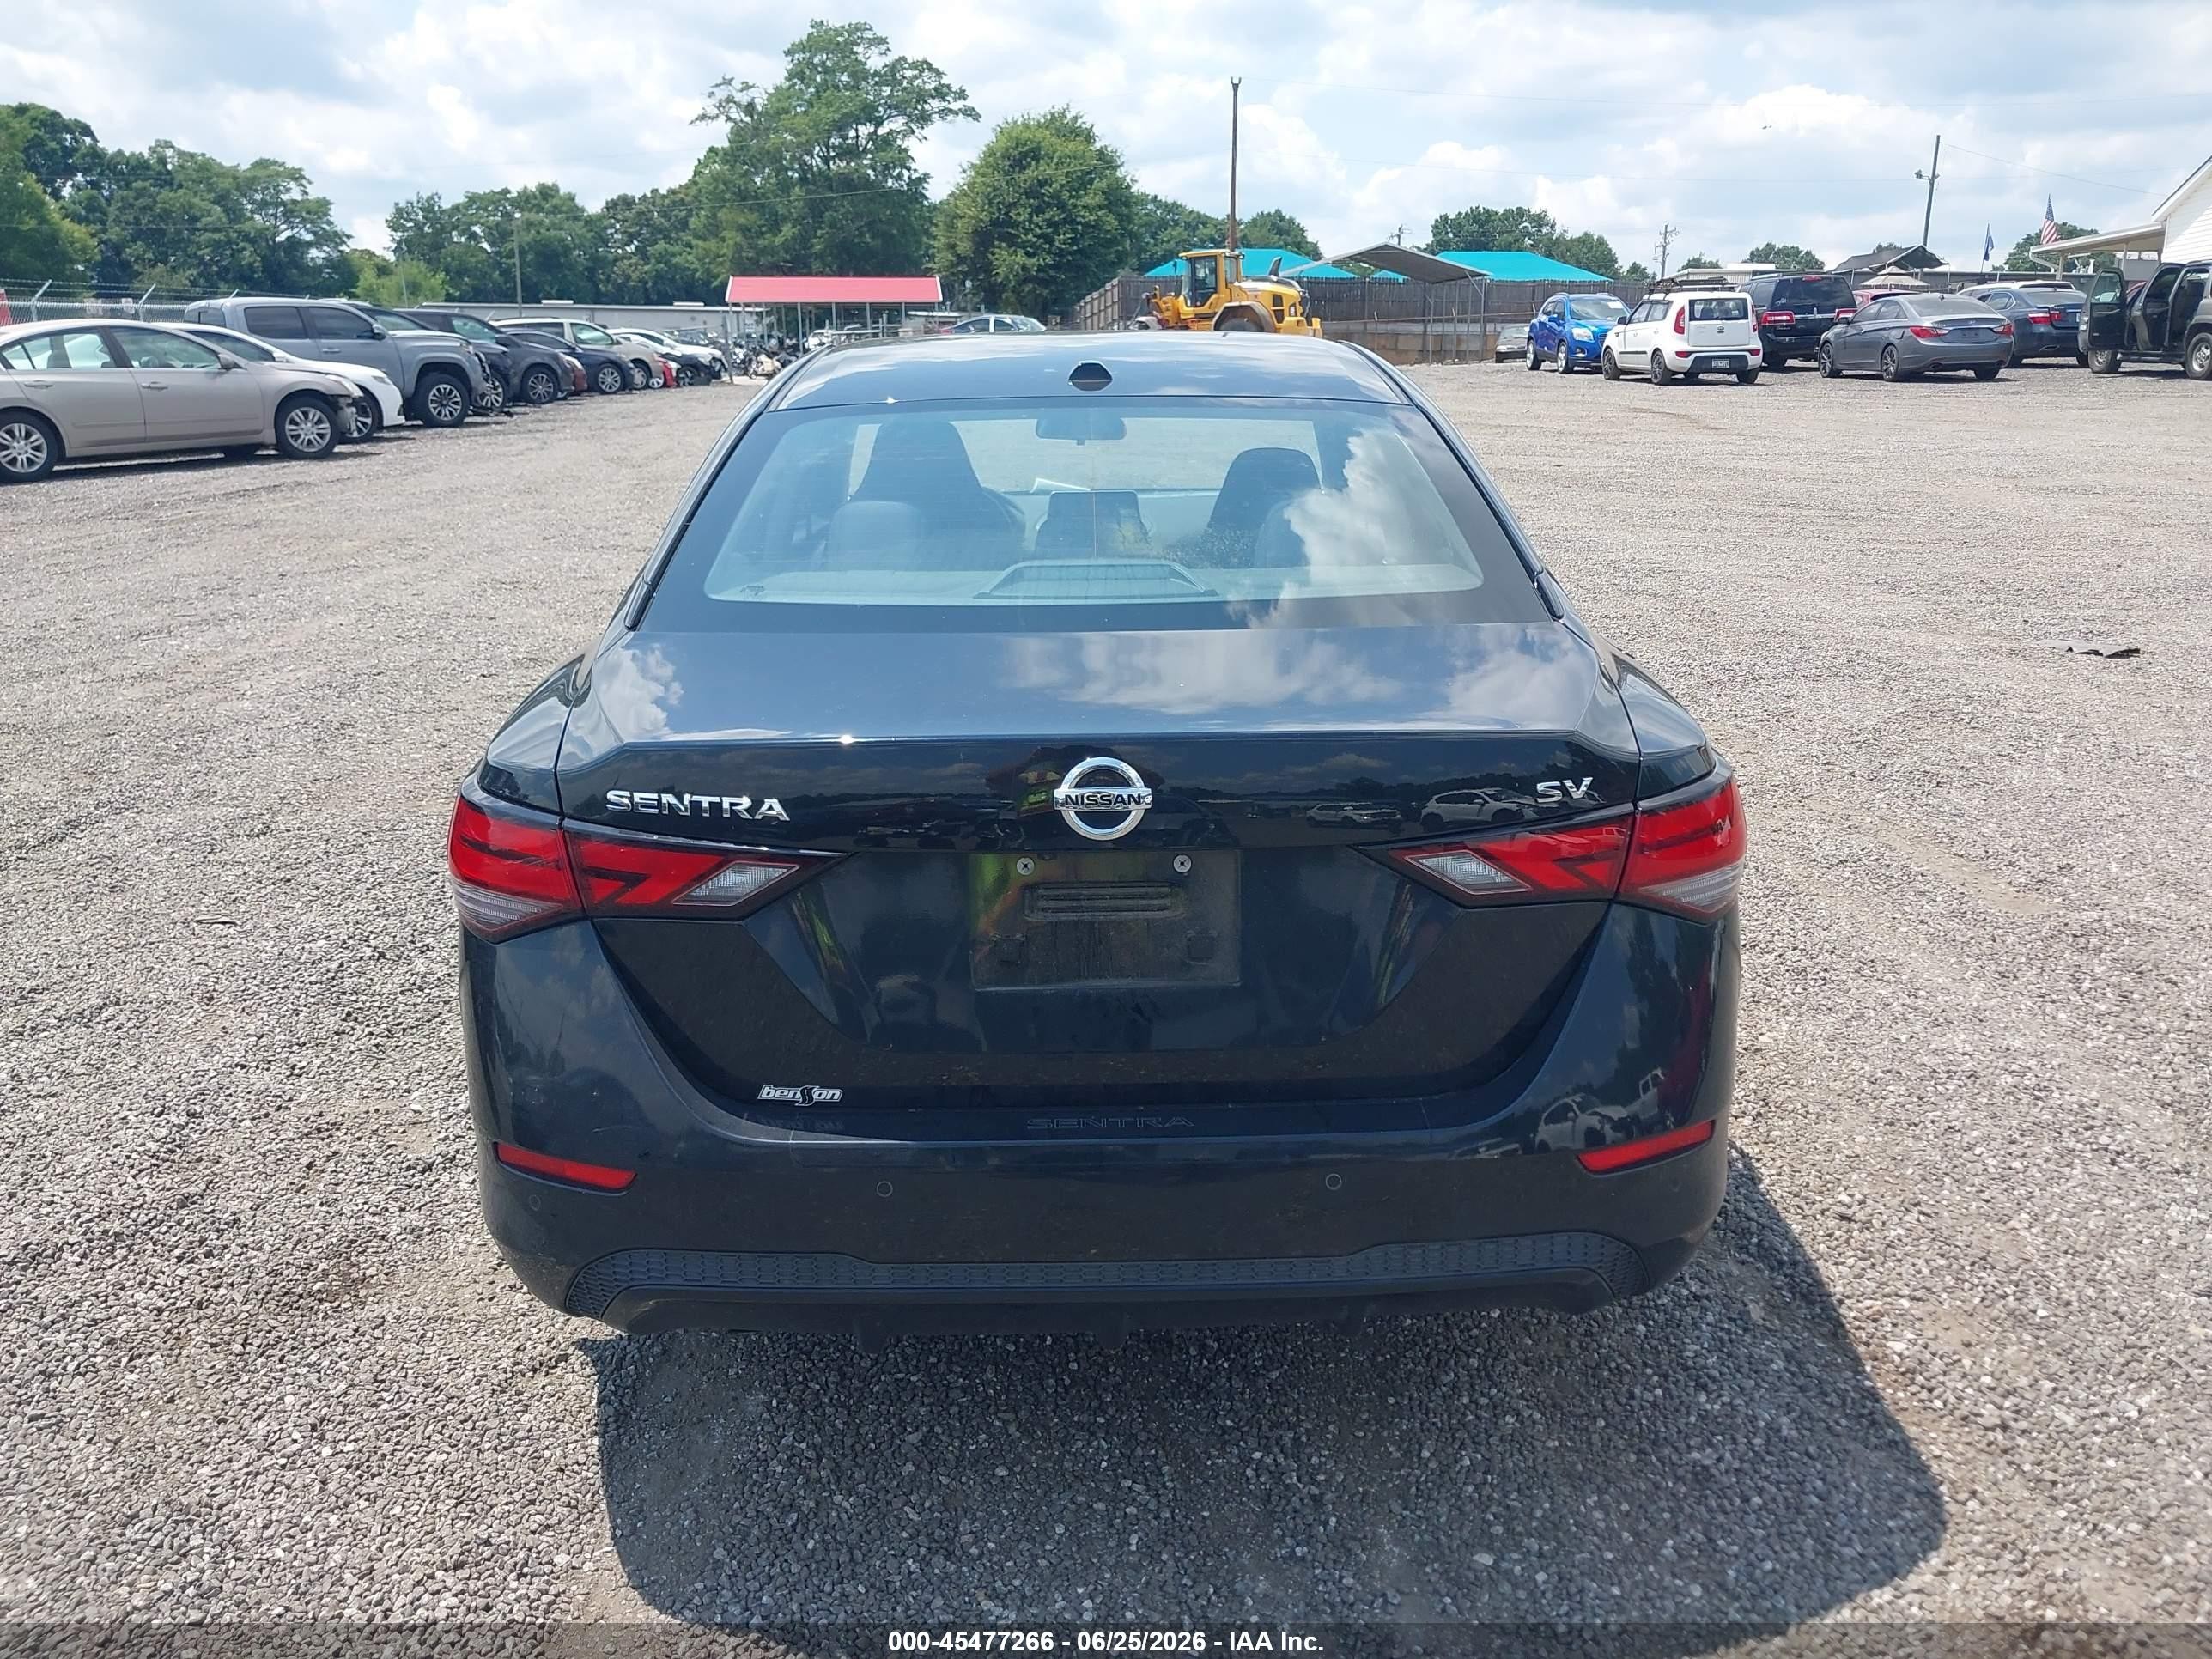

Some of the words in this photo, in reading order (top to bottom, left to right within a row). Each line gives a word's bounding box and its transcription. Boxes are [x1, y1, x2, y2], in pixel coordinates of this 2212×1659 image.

[1064, 793, 1142, 806] NISSAN
[1536, 776, 1594, 803] SV
[605, 790, 790, 821] SENTRA
[1027, 1116, 1194, 1128] SENTRA
